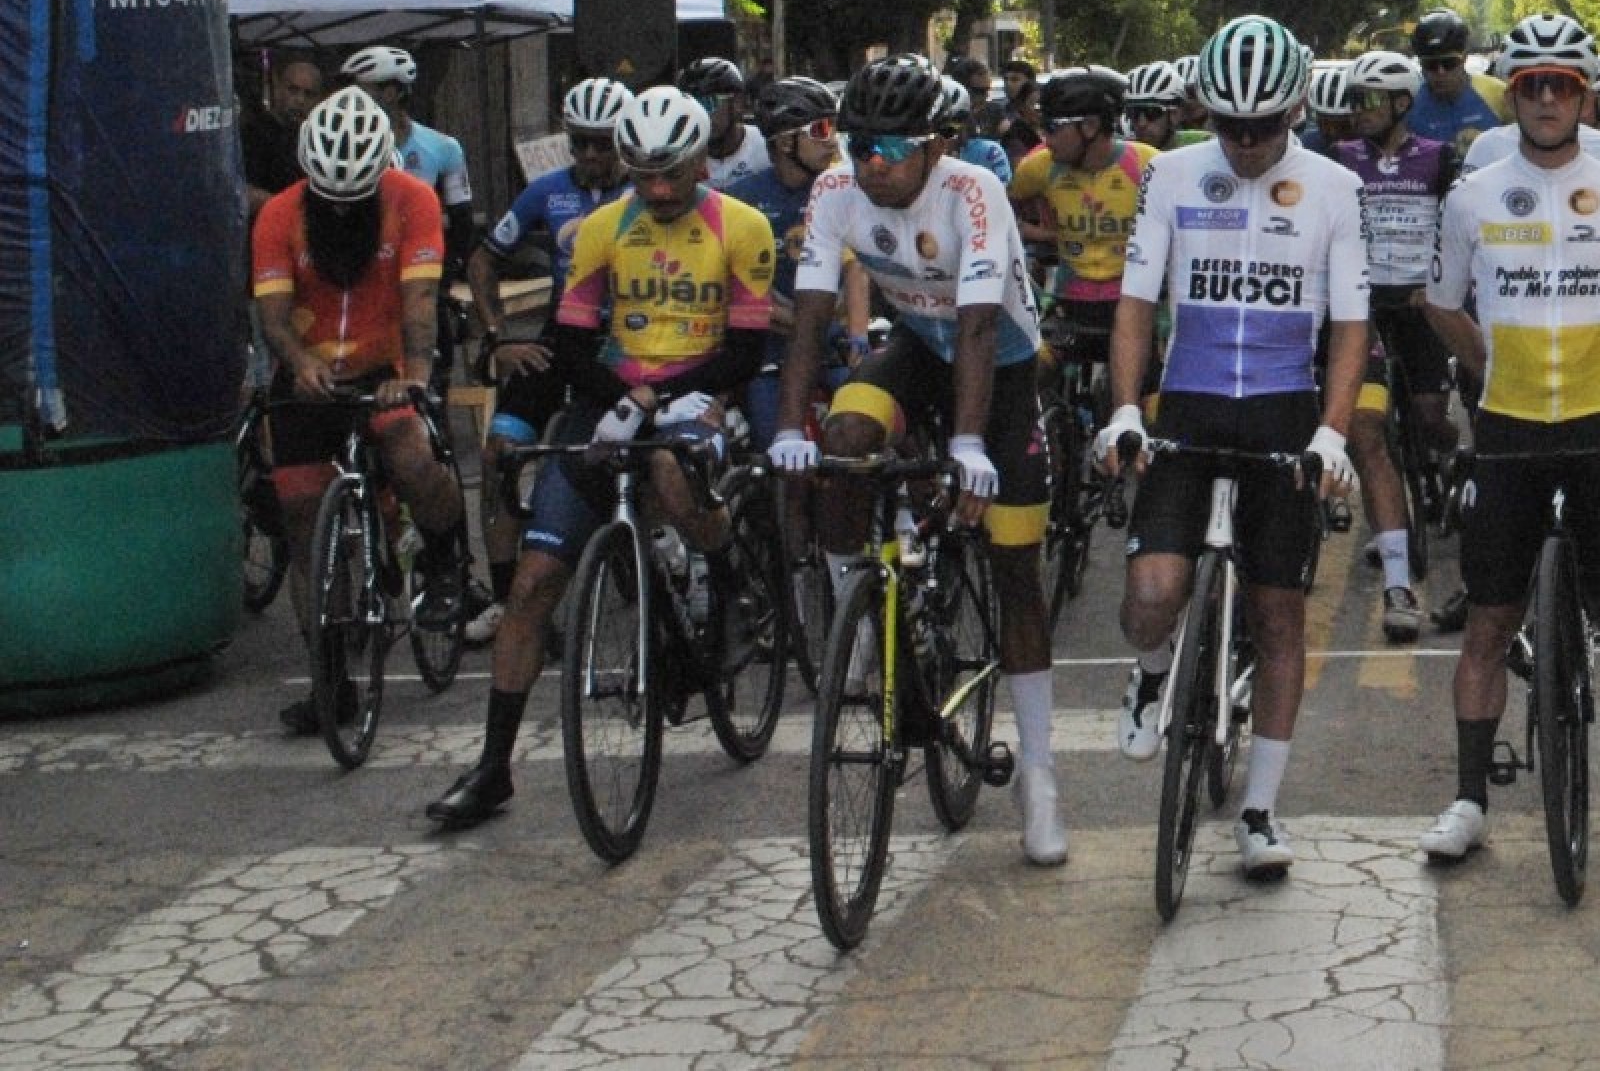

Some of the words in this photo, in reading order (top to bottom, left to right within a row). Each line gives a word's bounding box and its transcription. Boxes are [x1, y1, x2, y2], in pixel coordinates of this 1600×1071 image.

[611, 272, 724, 306] Luján
[1495, 265, 1541, 282] Pueblo
[1189, 274, 1303, 306] BUCCI
